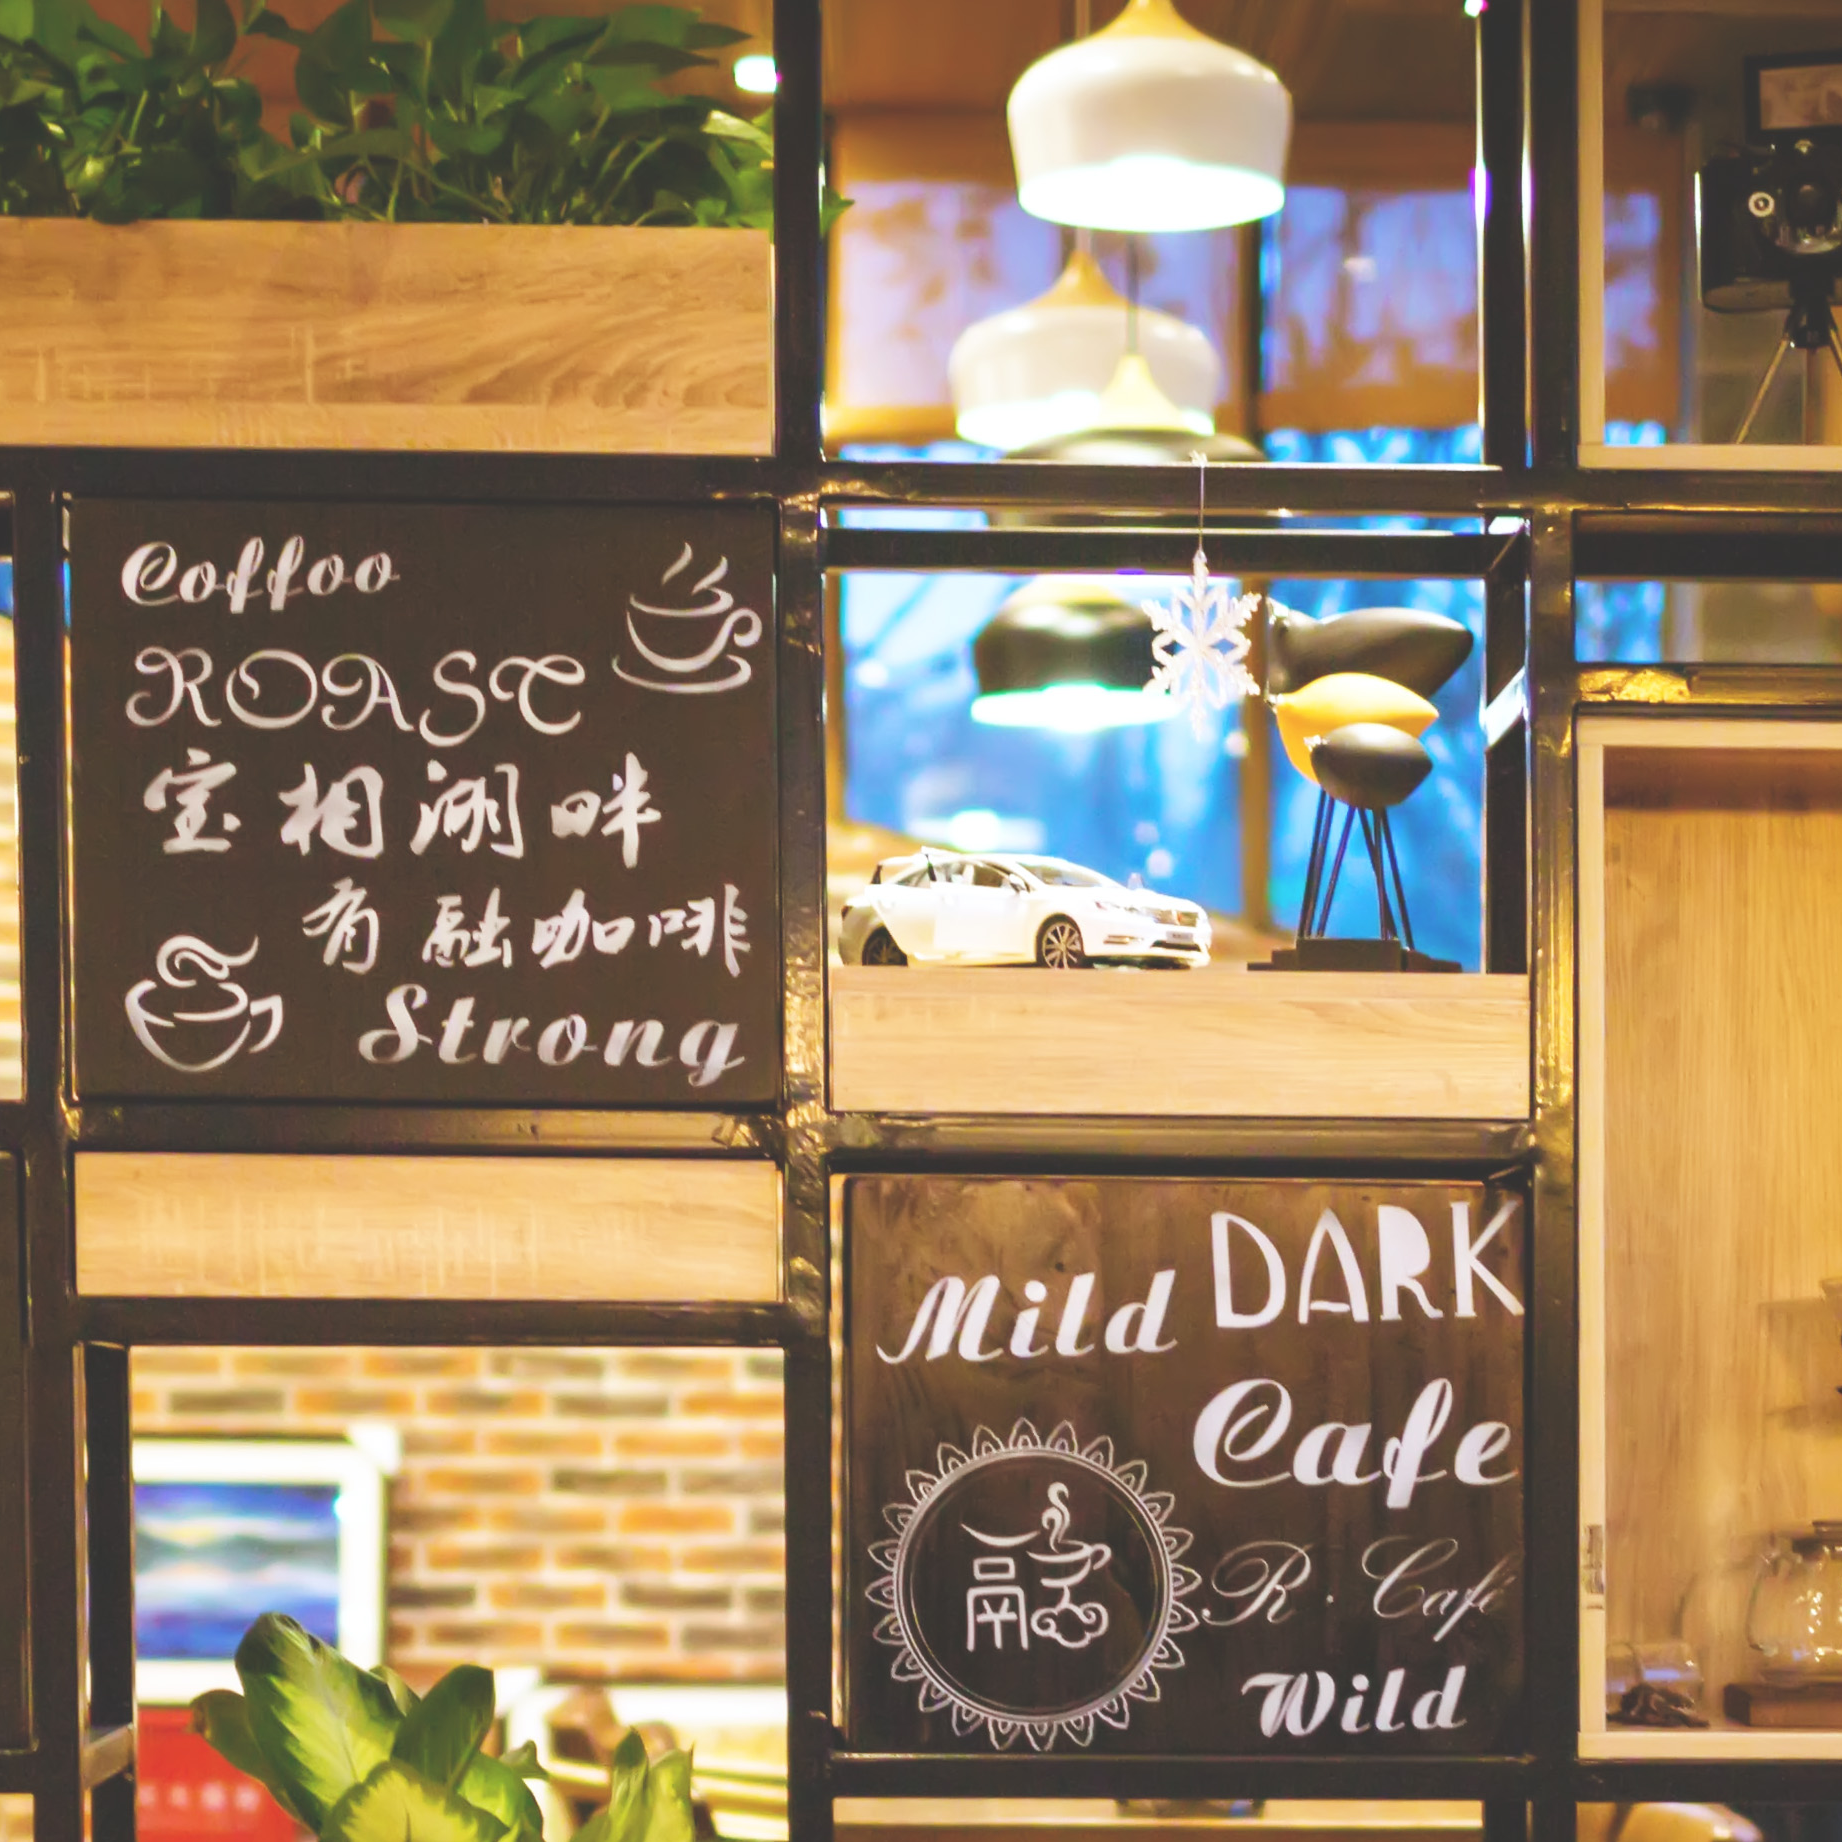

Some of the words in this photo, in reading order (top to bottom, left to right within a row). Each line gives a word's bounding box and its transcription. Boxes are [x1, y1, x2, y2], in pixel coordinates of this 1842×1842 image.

[303, 879, 750, 977] 有融咖啡
[359, 984, 745, 1086] Strong
[1211, 1201, 1524, 1328] DARK
[877, 1270, 1177, 1363] Mild
[1193, 1378, 1518, 1508] Cafe
[1241, 1665, 1466, 1737] Wild
